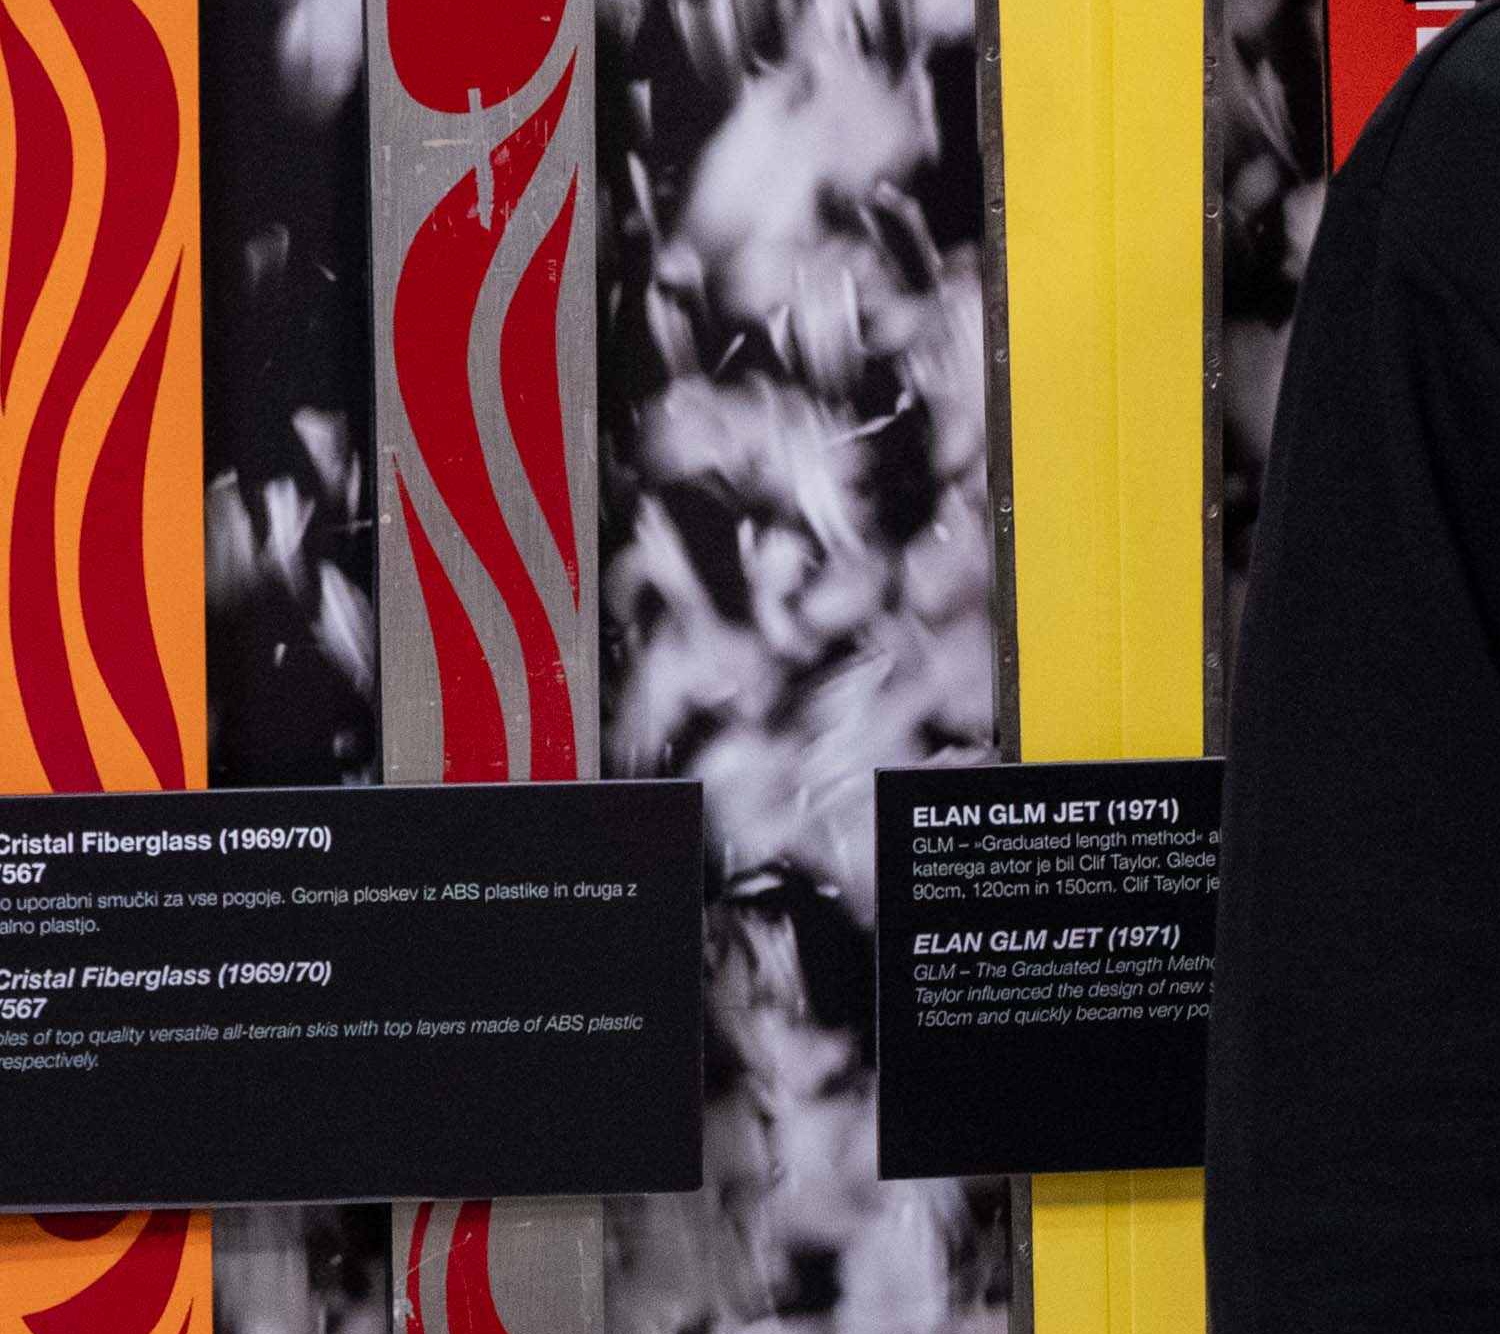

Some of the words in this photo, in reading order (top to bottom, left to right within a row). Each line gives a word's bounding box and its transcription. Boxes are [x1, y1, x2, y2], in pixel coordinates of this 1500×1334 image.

[913, 804, 980, 828] ELAN
[988, 802, 1046, 825] GLM
[1053, 800, 1100, 823] JET
[1108, 797, 1179, 825] (1971)
[82, 830, 212, 856] Fiberglass
[219, 826, 332, 854] (1969/70)
[912, 836, 954, 854] GLM
[1076, 831, 1127, 851] length
[912, 859, 985, 879] katerega
[990, 858, 1032, 875] avtor
[1036, 856, 1050, 877] je
[1055, 855, 1074, 872] bil
[1079, 853, 1106, 871] Clif
[1110, 853, 1160, 874] Taylor.
[1166, 851, 1216, 869] Glede
[17, 892, 92, 913] uporabni
[97, 890, 159, 909] smučki
[163, 894, 183, 907] za
[188, 892, 218, 906] vse
[222, 889, 286, 910] pogoje.
[291, 886, 349, 907] Gornja
[354, 885, 419, 906] ploskev
[423, 884, 437, 901] iz
[441, 882, 480, 901] ABS
[485, 881, 550, 903] plastike
[554, 882, 568, 898] in
[574, 881, 623, 901] druga
[627, 883, 637, 897] z
[973, 880, 1030, 897] 120cm
[1035, 879, 1049, 895] in
[1122, 875, 1149, 892] Clif
[1153, 874, 1201, 894] Taylor
[40, 916, 101, 937] plastjo.
[913, 932, 982, 955] ELAN
[990, 930, 1048, 952] GLM
[1053, 927, 1103, 950] JET
[1108, 924, 1181, 952] (1971)
[81, 965, 211, 991] Fiberglass
[218, 961, 332, 989] (1969/70)
[913, 963, 956, 982] GLM
[977, 962, 1007, 979] The
[1011, 959, 1100, 977] Graduated
[1105, 956, 1163, 977] Length
[916, 987, 963, 1007] Taylor
[967, 984, 1051, 1002] influenced
[1056, 982, 1083, 999] the
[1088, 979, 1143, 1001] design
[1147, 978, 1165, 995] of
[1169, 981, 1204, 995] new
[916, 1009, 972, 1027] 150cm
[977, 1008, 1009, 1025] and
[1014, 1005, 1071, 1026] quickly
[1076, 1004, 1143, 1021] became
[1148, 1003, 1182, 1021] very
[33, 1028, 52, 1046] of
[56, 1029, 83, 1048] top
[89, 1026, 144, 1049] quality
[150, 1025, 219, 1042] versatile
[223, 1023, 302, 1042] all-terrain
[306, 1021, 338, 1039] skis
[343, 1019, 378, 1037] with
[383, 1020, 412, 1039] top
[416, 1017, 466, 1039] layers
[471, 1017, 520, 1034] made
[523, 1016, 544, 1033] of
[544, 1015, 585, 1032] ABS
[587, 1014, 643, 1035] plastic
